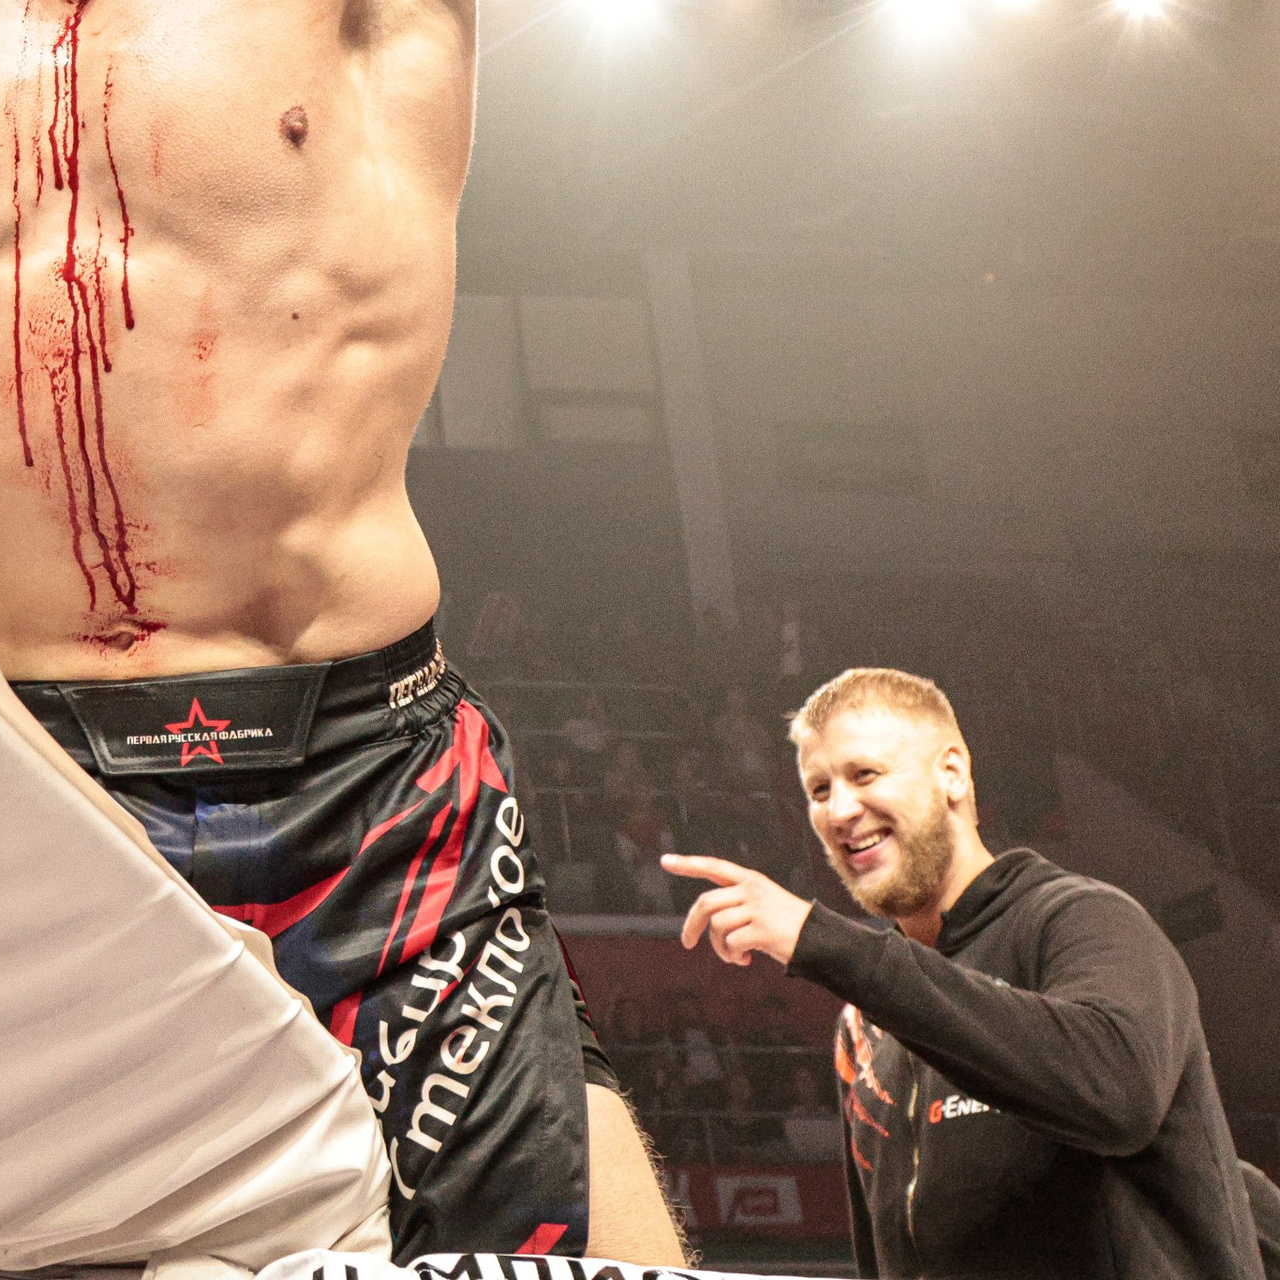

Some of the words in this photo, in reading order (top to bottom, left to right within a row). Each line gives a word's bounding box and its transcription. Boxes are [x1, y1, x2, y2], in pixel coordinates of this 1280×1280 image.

[126, 734, 168, 745] ПЕРВАЯ
[168, 731, 218, 743] РУССКАЯ
[219, 727, 274, 739] ФАБРИКА
